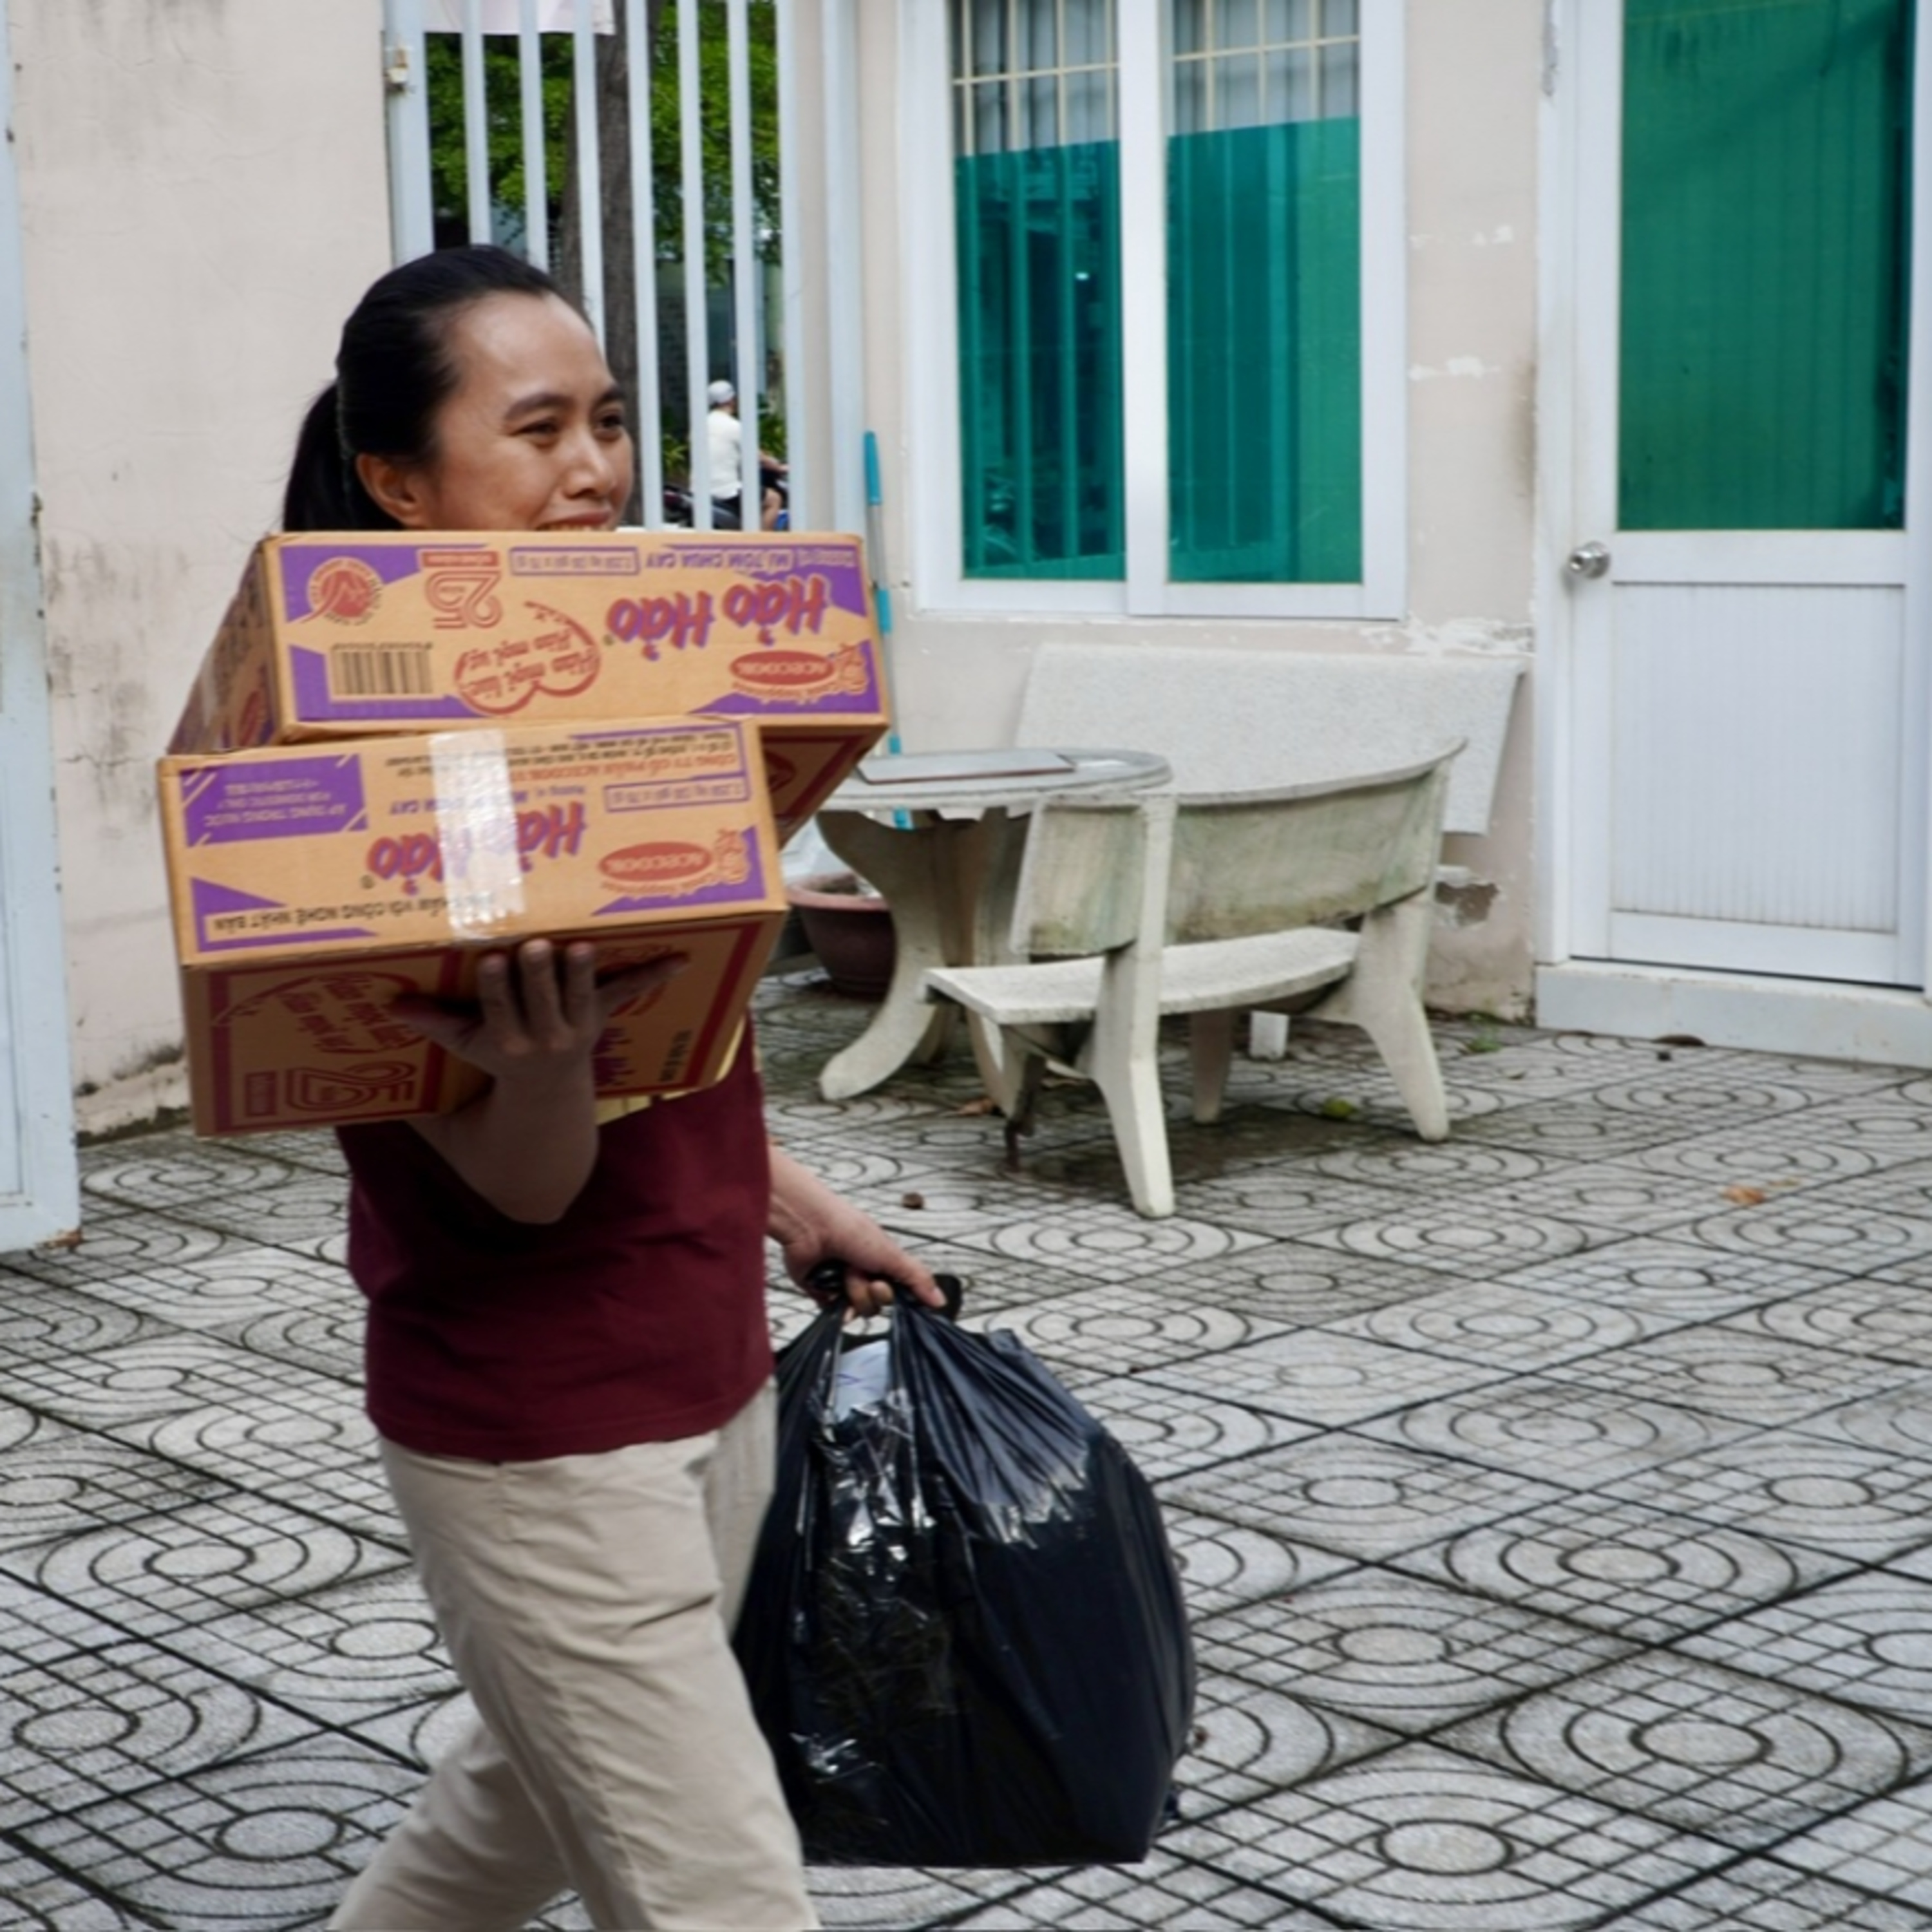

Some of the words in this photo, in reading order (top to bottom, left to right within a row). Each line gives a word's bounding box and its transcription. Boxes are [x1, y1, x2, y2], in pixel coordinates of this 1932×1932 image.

[645, 553, 676, 571] CAY
[424, 572, 503, 629] 25
[723, 575, 827, 647] Hảo
[605, 591, 715, 663] Hảo
[736, 660, 826, 677] ACECOOK
[605, 852, 705, 873] ACECOOK
